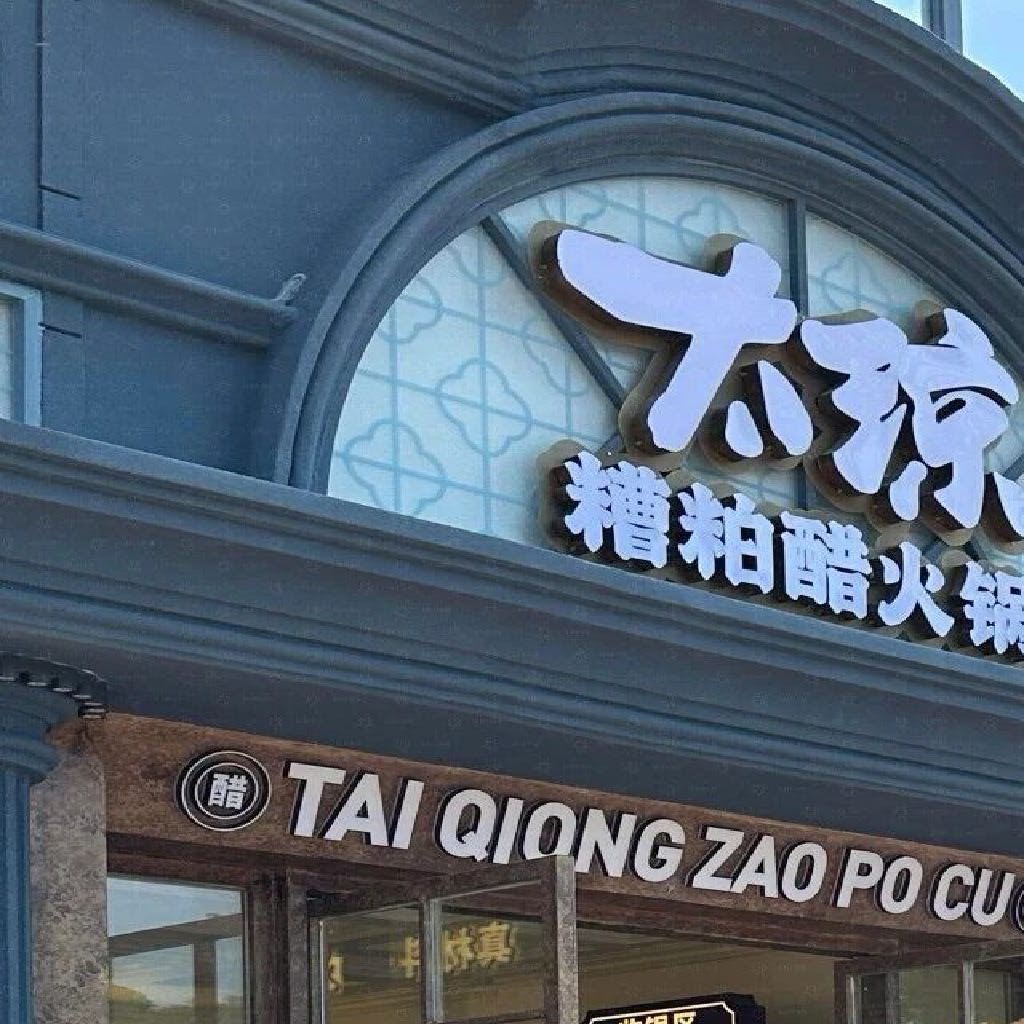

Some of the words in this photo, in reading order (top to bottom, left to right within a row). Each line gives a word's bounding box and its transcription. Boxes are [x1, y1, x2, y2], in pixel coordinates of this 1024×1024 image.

[206, 772, 248, 811] 醋
[286, 762, 425, 850] TAI
[438, 788, 686, 883] QIONG
[692, 825, 828, 903] ZAO
[836, 848, 924, 916] PO
[931, 865, 1016, 926] CU
